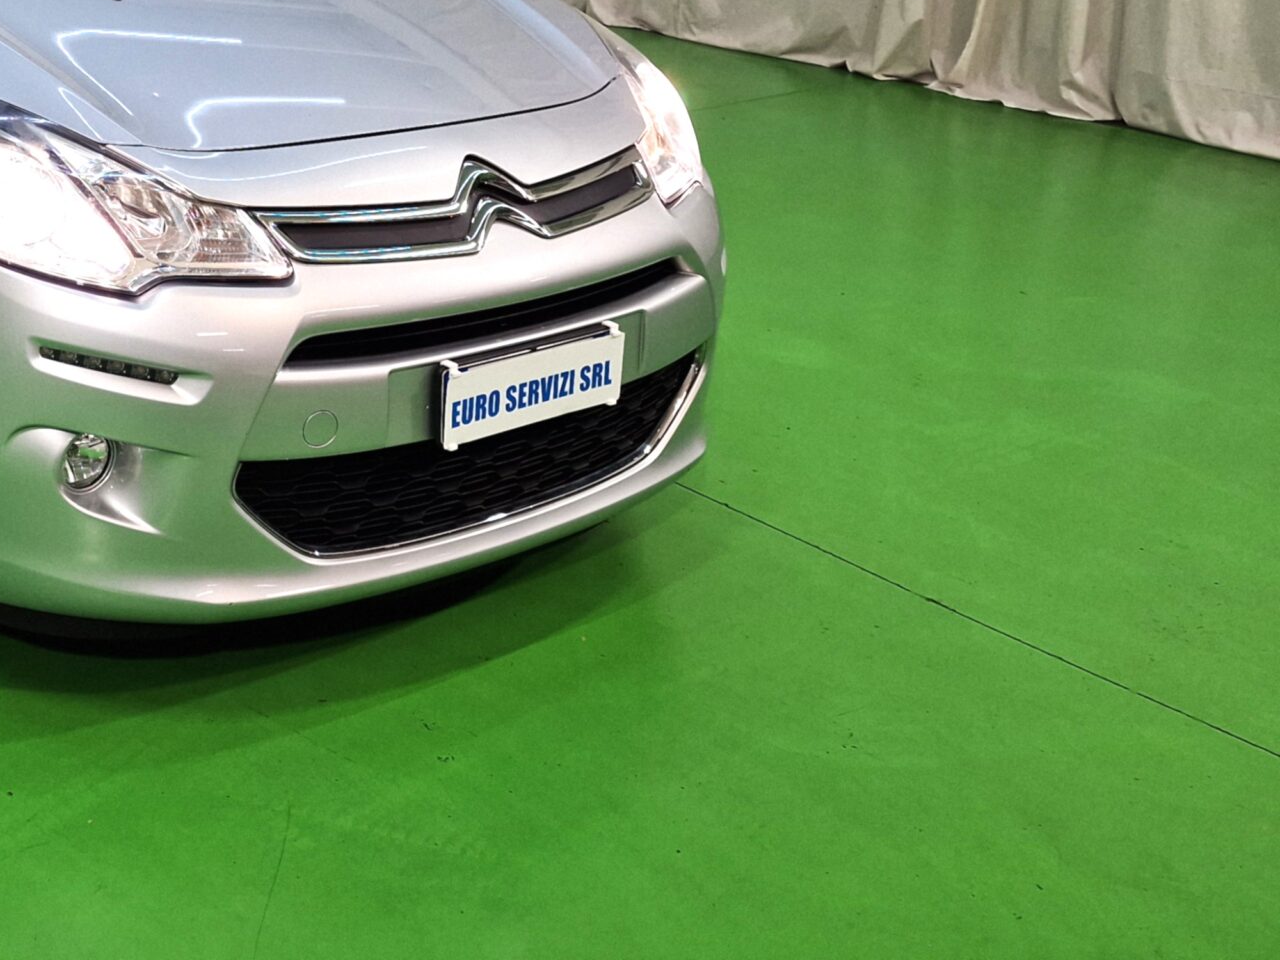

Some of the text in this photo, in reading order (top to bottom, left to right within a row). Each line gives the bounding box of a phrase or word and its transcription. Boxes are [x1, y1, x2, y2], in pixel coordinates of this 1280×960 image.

[451, 360, 612, 429] EURO SERVIZI SRL
